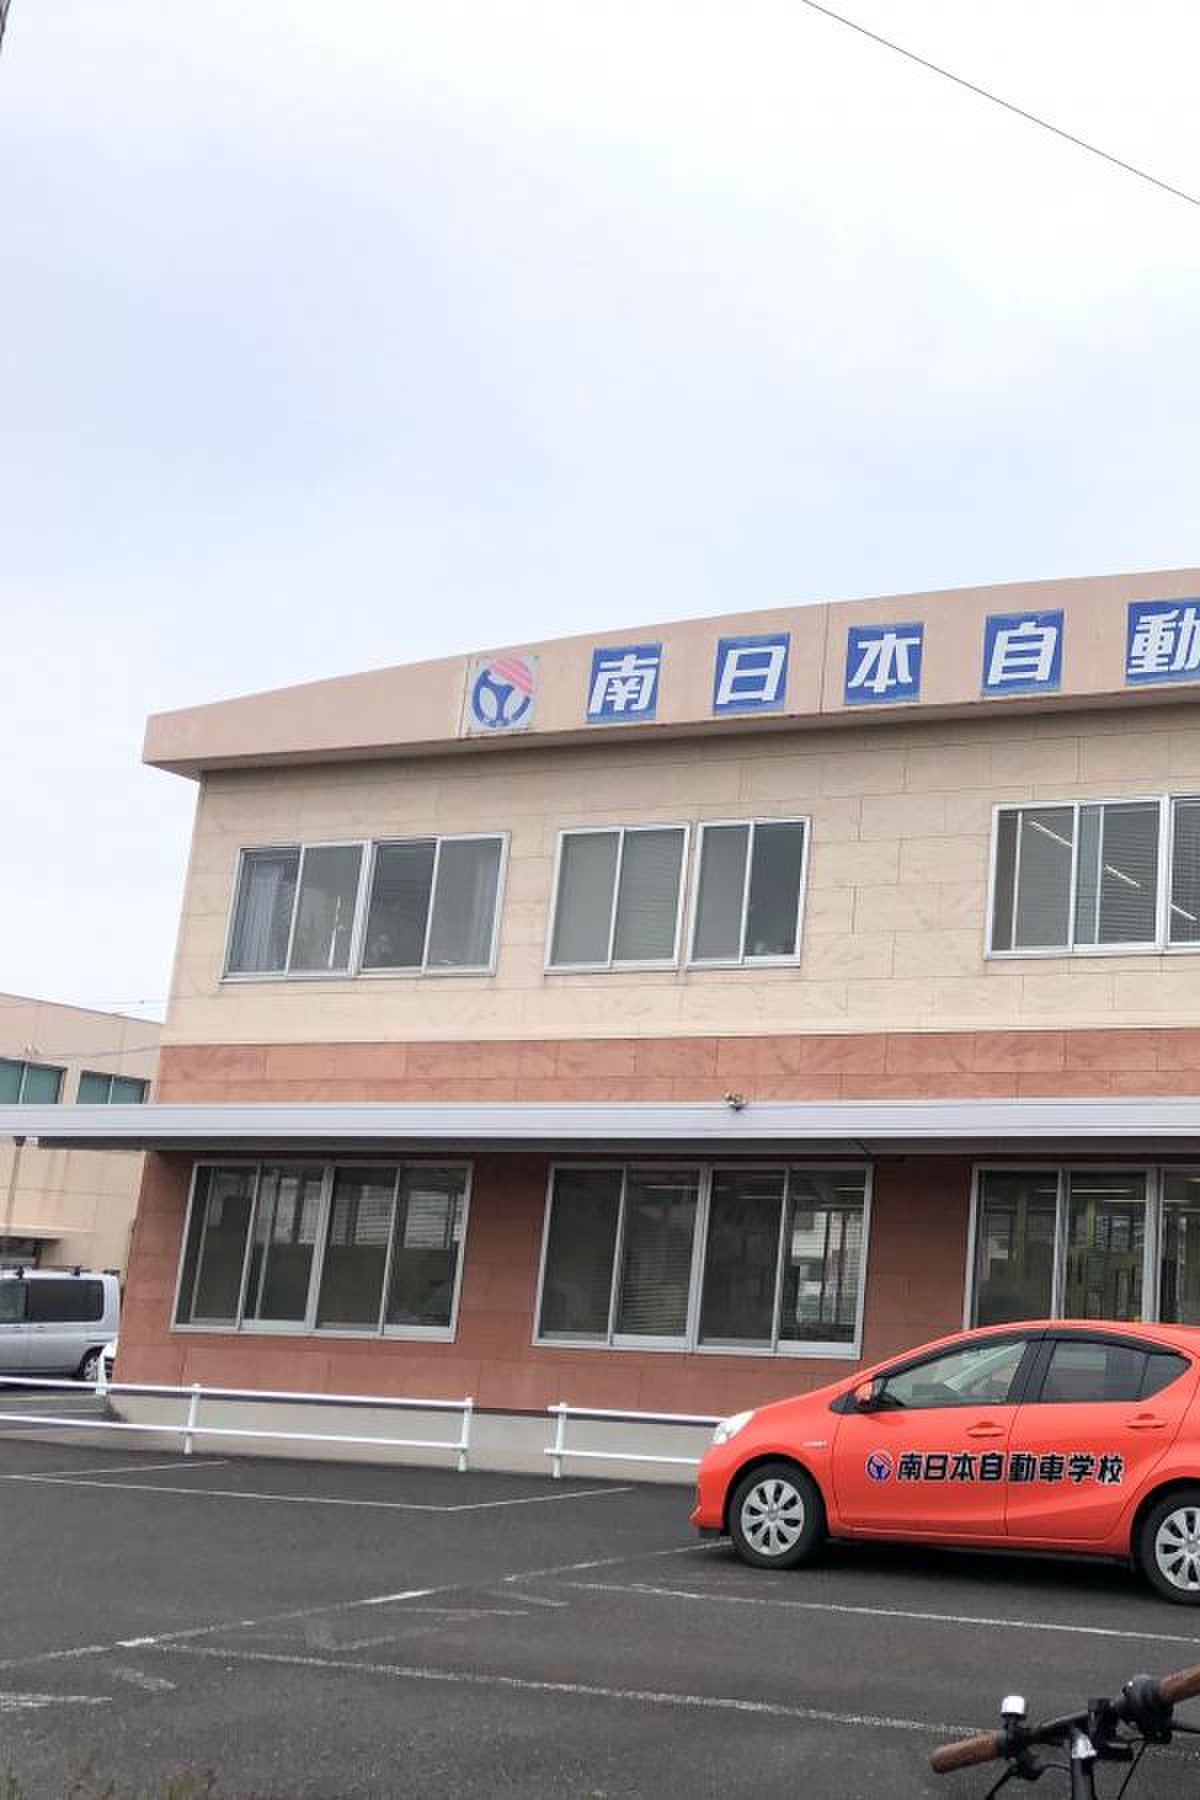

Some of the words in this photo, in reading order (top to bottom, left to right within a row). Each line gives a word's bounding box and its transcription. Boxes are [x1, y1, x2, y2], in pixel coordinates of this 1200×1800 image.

[896, 1453, 1123, 1482] 南日本自動車学校
